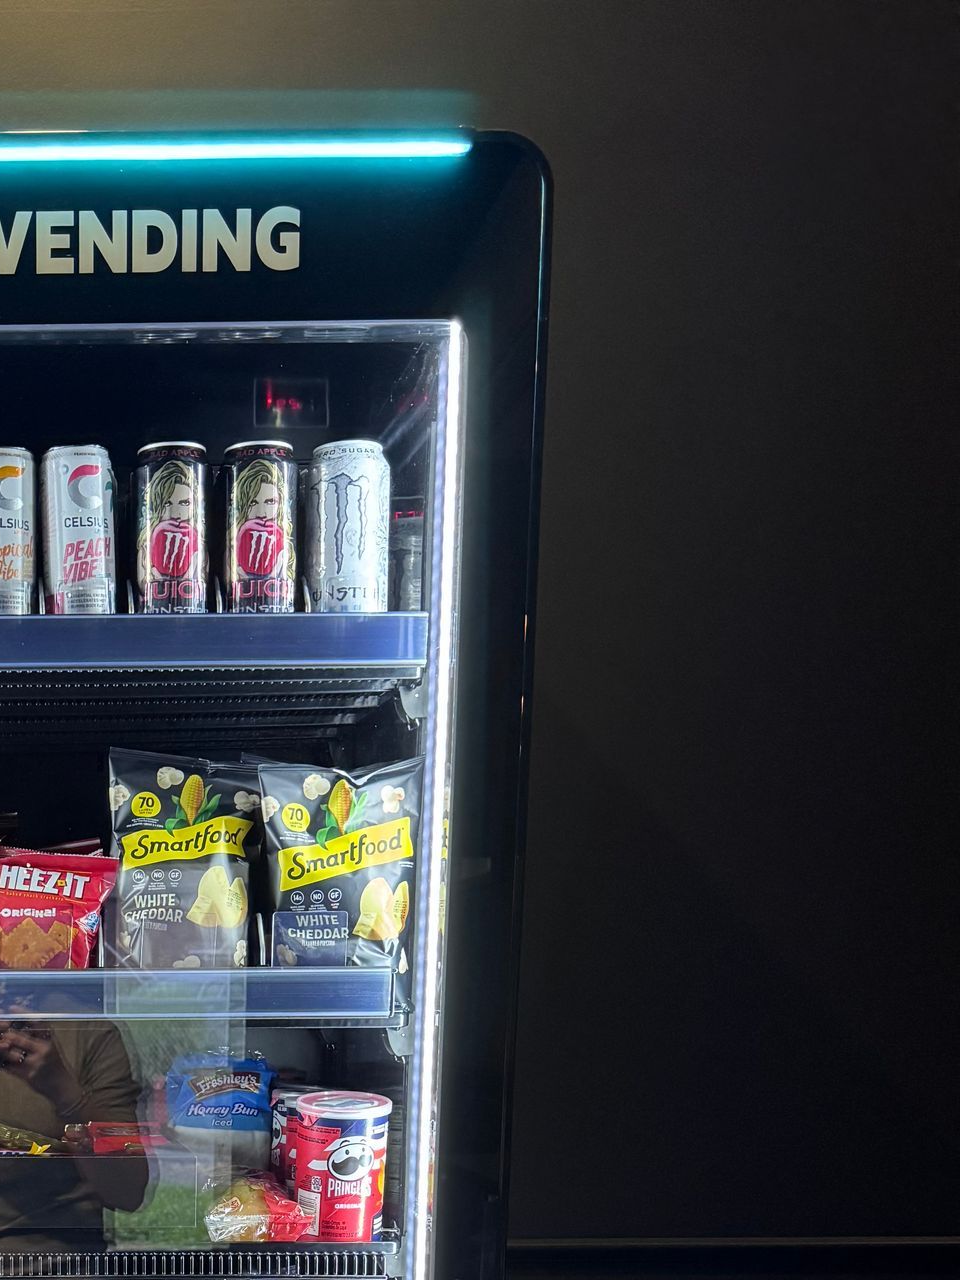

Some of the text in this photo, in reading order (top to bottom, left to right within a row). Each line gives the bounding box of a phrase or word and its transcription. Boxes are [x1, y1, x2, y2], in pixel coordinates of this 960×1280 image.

[63, 516, 109, 530] CELSIUS
[63, 536, 111, 564] PEACH
[62, 558, 98, 585] VIBE
[138, 796, 155, 808] 70
[287, 807, 304, 822] 70
[130, 824, 243, 860] Smartfood
[287, 828, 403, 881] Smartfood
[134, 893, 176, 909] WHITE
[330, 891, 341, 899] GF
[124, 908, 183, 923] CHEDDAR
[295, 914, 340, 927] WHITE
[288, 927, 350, 939] CHEDDAR
[196, 1072, 258, 1092] Freshley's
[186, 1103, 258, 1117] Honey Bun
[210, 1117, 233, 1127] Iced
